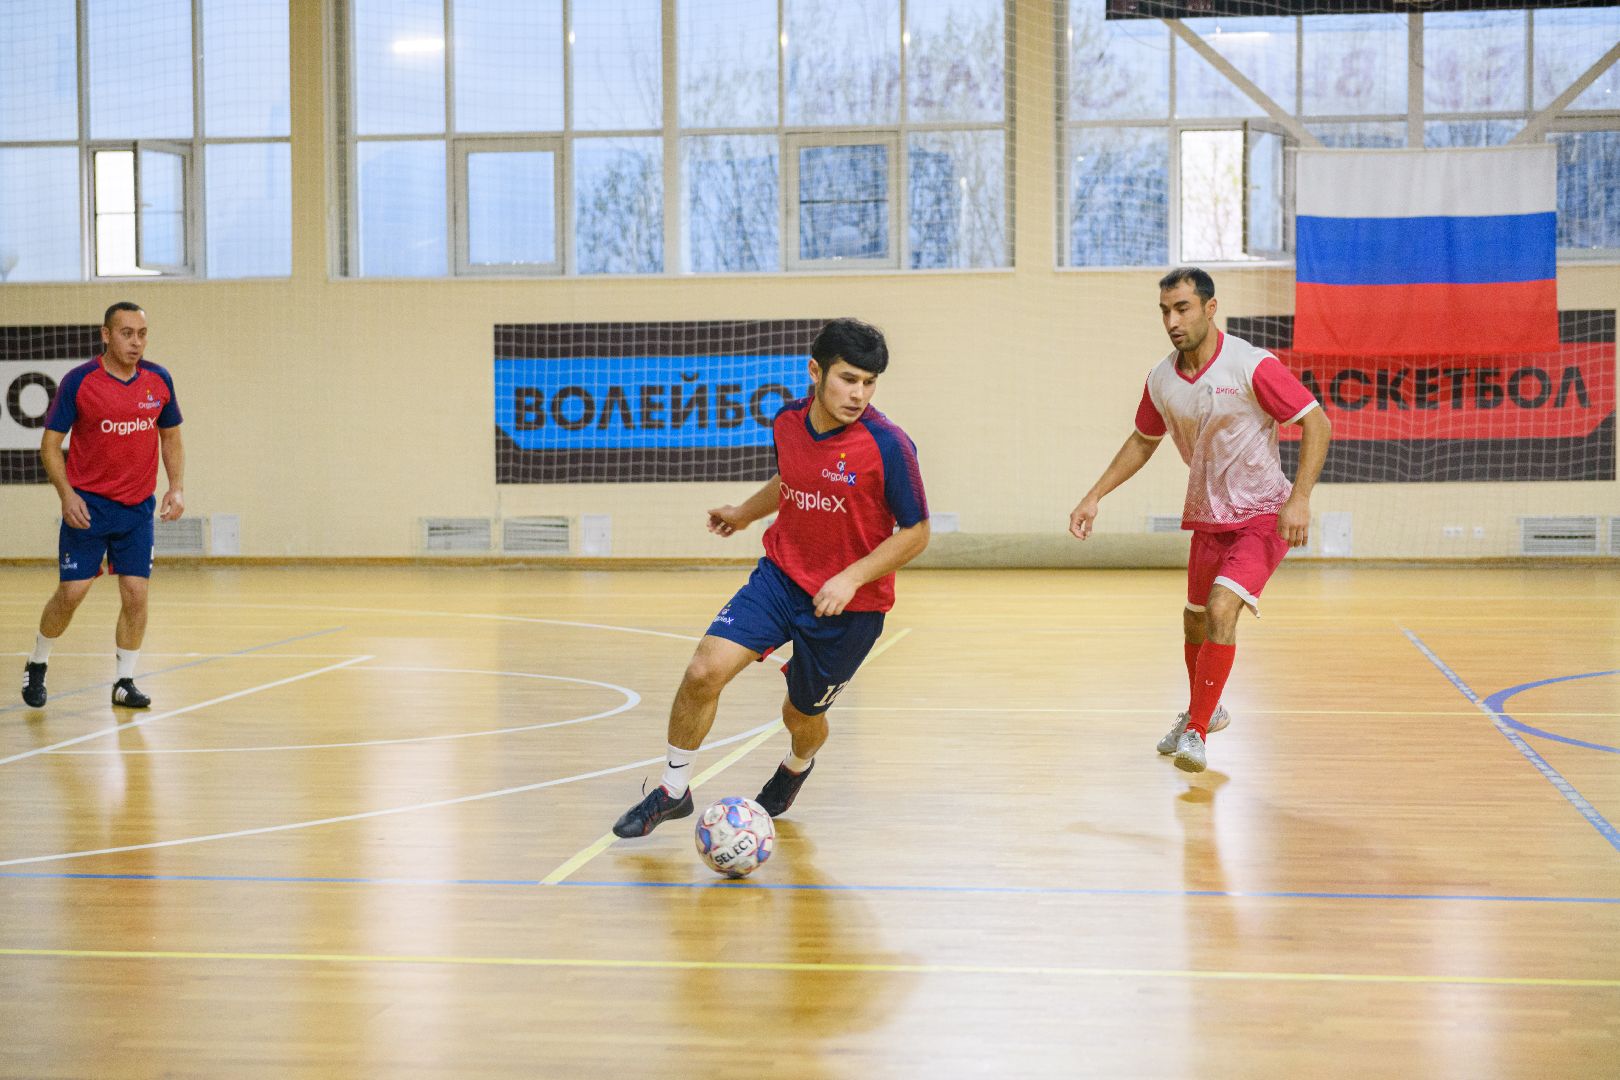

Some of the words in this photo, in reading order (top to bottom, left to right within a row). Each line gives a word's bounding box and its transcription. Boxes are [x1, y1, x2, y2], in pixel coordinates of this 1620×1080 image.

[514, 371, 816, 431] ВОЛЕЙБО
[1301, 366, 1592, 412] АСКЕТБОЛ
[101, 416, 157, 436] OrgpleX
[821, 468, 857, 486] OrgpleX
[779, 482, 848, 513] OrgpleX
[714, 836, 753, 866] SELECT
